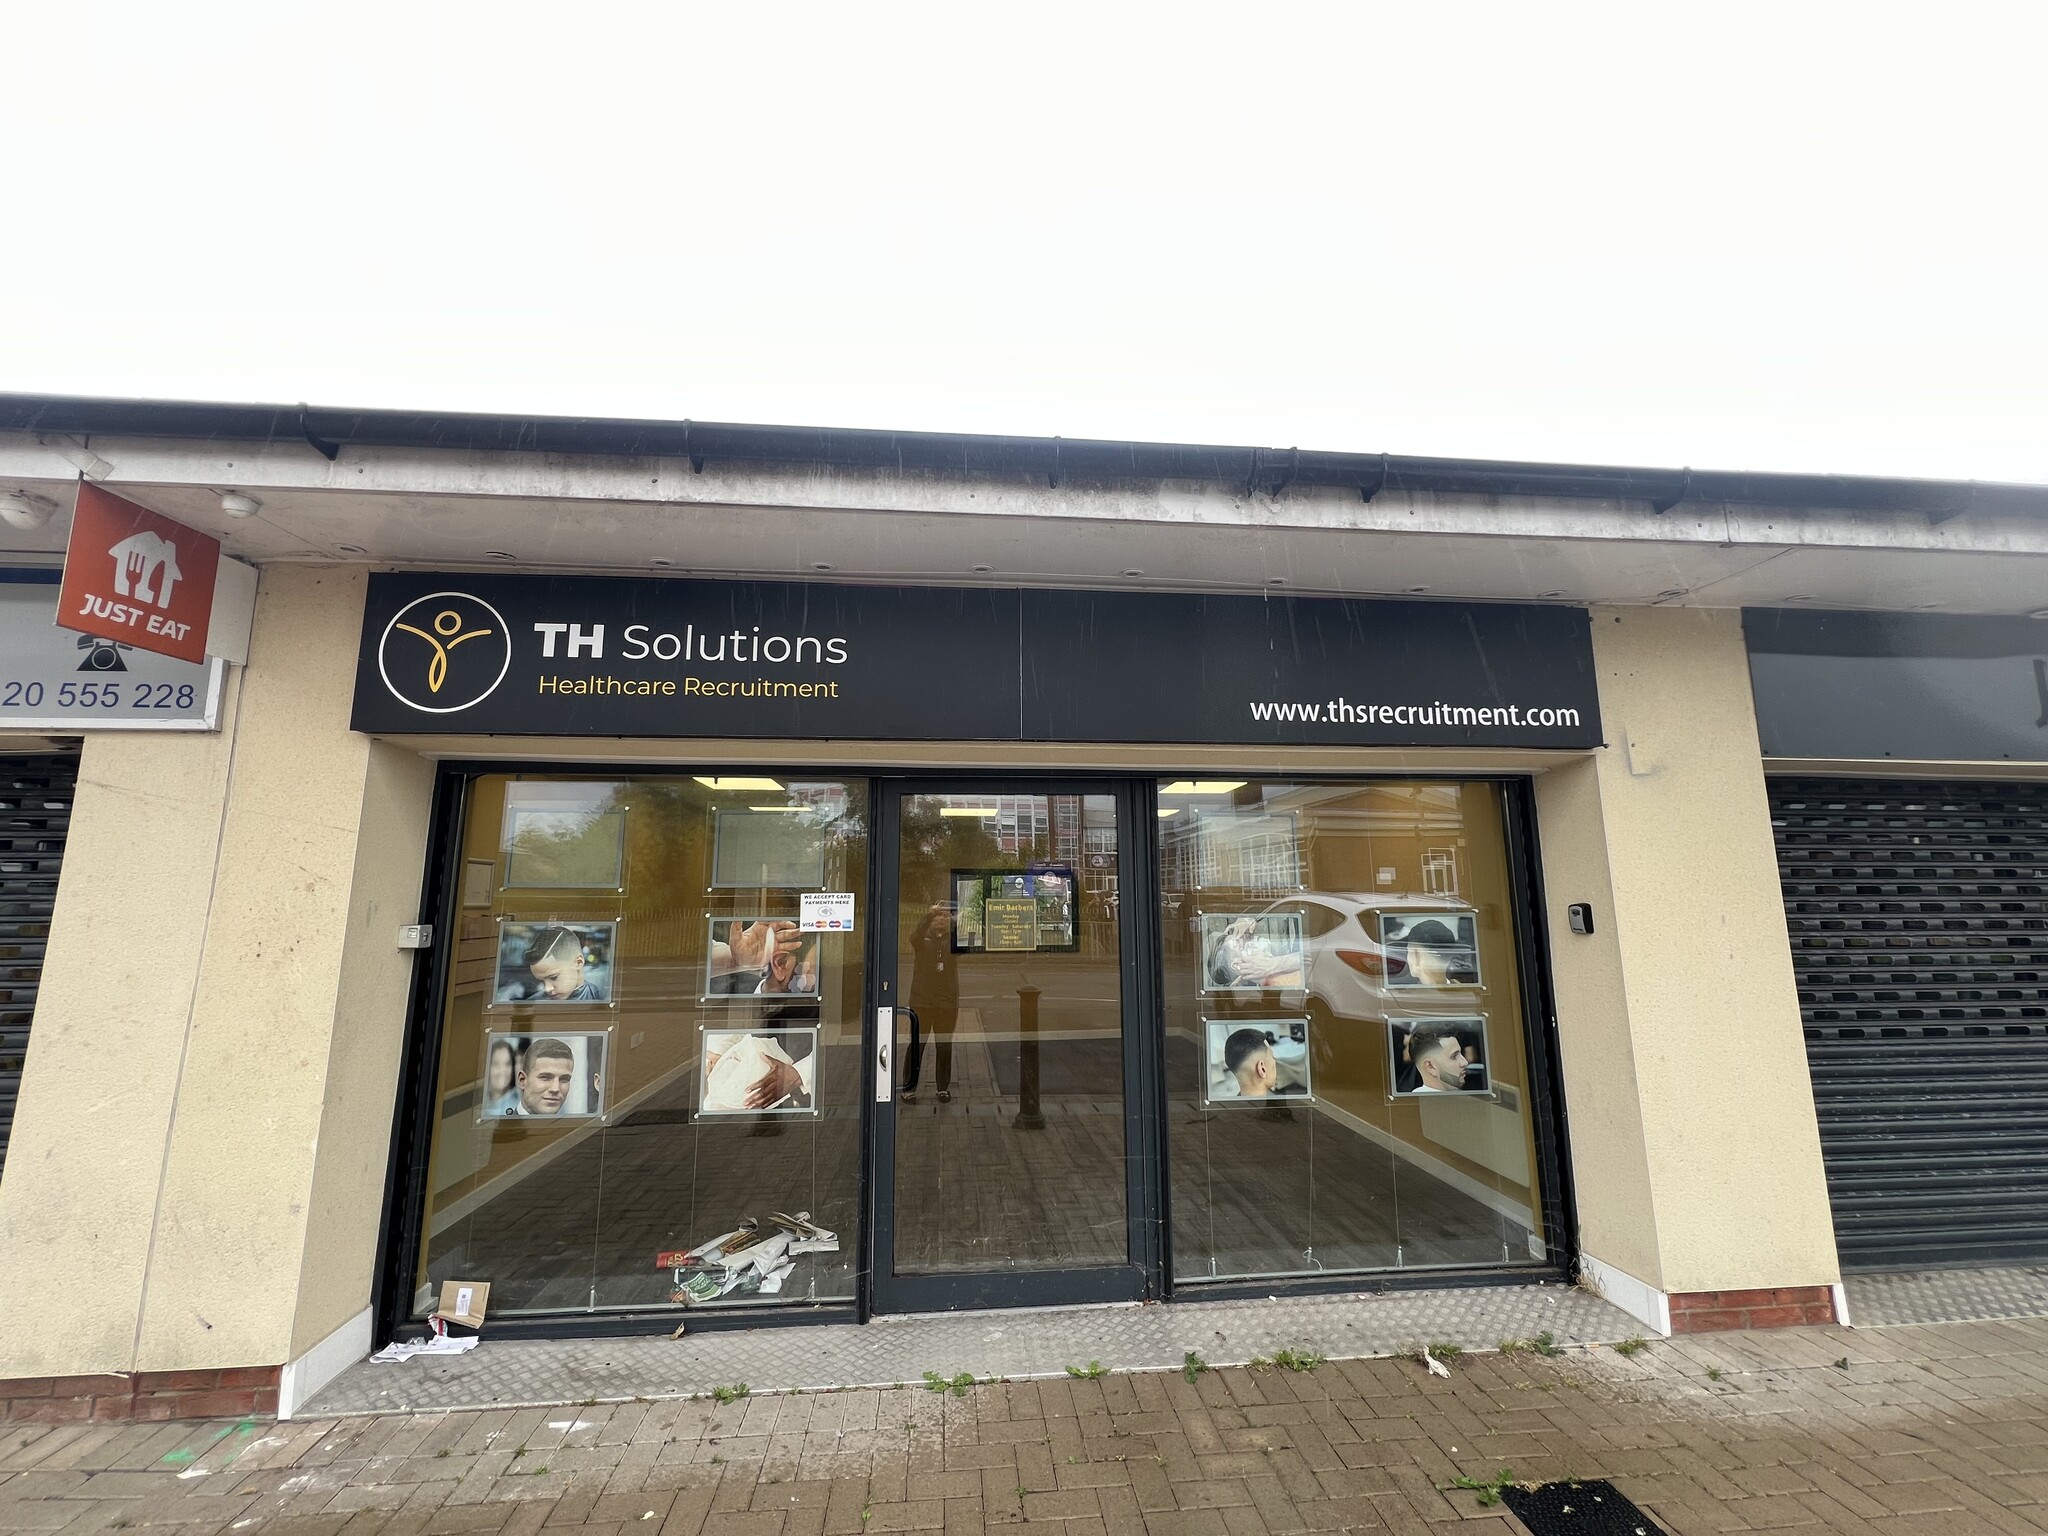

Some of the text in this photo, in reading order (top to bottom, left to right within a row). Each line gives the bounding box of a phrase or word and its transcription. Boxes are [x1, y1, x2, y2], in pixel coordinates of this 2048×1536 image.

[79, 593, 191, 641] JUST EAT
[533, 622, 848, 665] TH Solutions
[57, 682, 119, 708] 555
[132, 683, 194, 709] 228
[538, 675, 839, 698] Healthcare Recruitment
[1250, 697, 1580, 727] www.thsrecruitment.com
